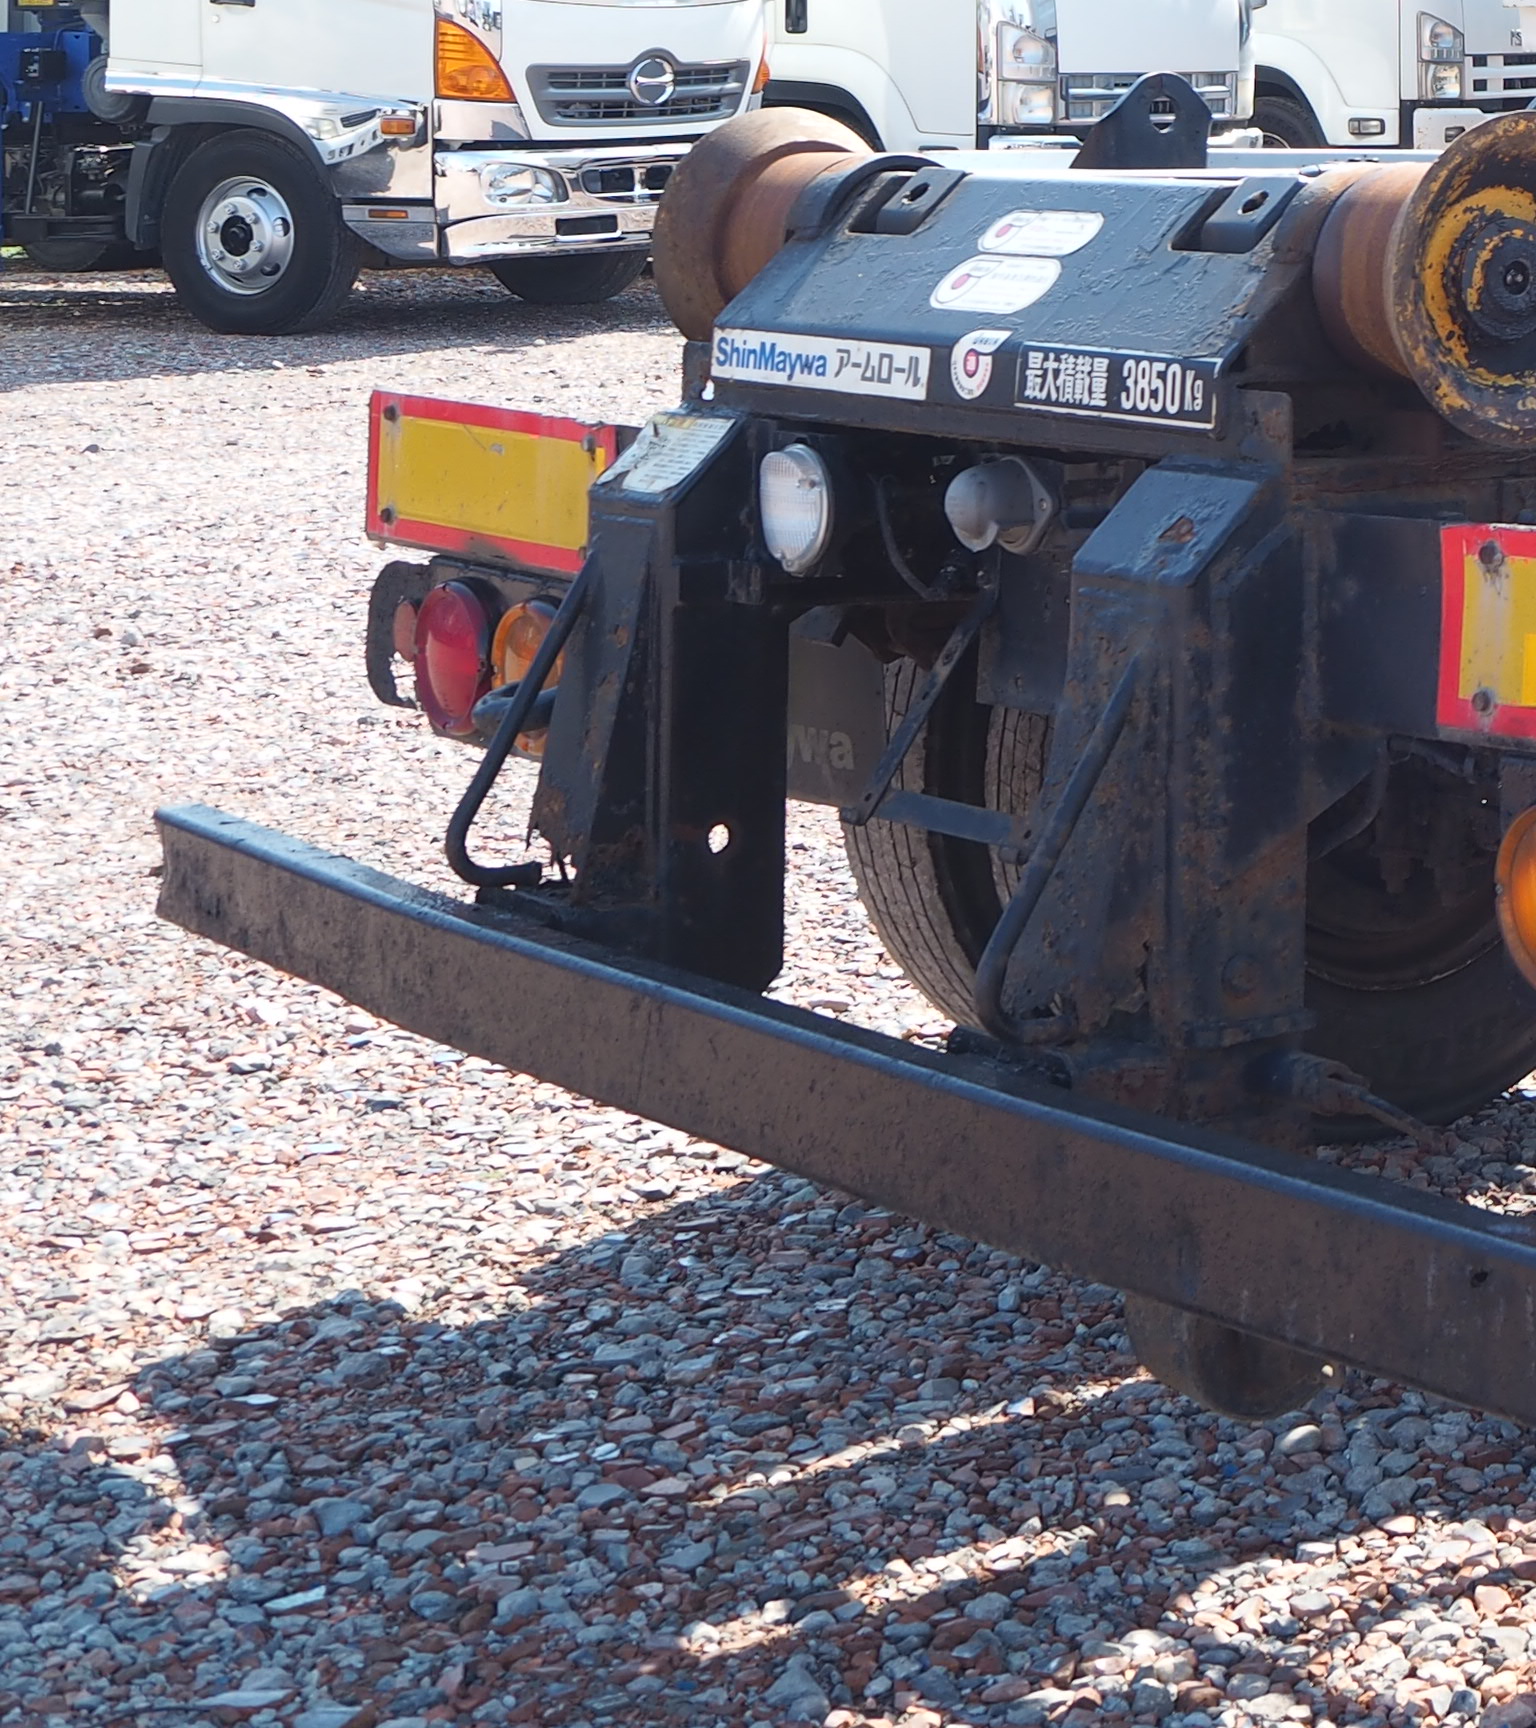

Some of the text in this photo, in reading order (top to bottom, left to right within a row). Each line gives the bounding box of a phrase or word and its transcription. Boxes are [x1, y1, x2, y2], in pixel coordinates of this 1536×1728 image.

[715, 336, 828, 382] ShinMaywa
[833, 347, 922, 387] アームロール
[1024, 350, 1109, 409] 最大積載量
[1120, 361, 1180, 416] 3850
